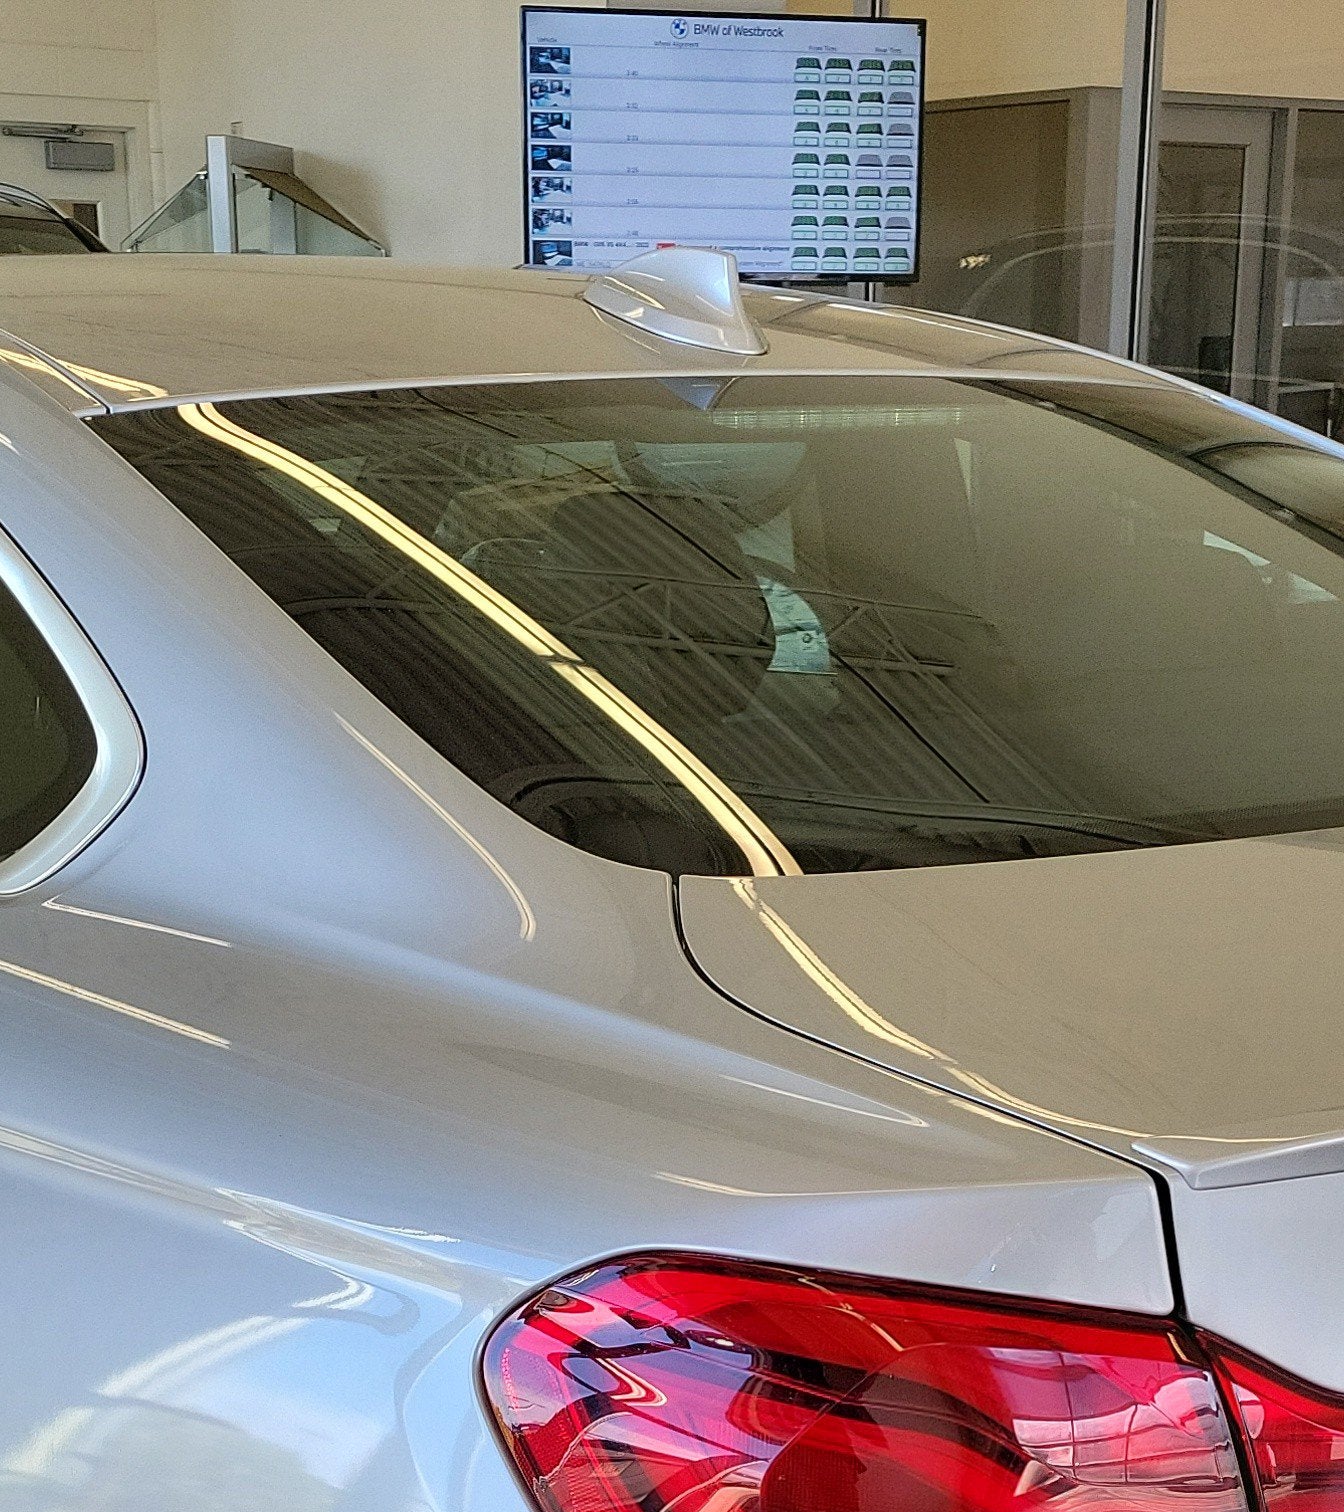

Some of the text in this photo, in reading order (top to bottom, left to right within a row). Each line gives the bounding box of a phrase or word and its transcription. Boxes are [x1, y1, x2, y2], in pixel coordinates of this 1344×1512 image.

[693, 23, 785, 38] BMW of Westbrook
